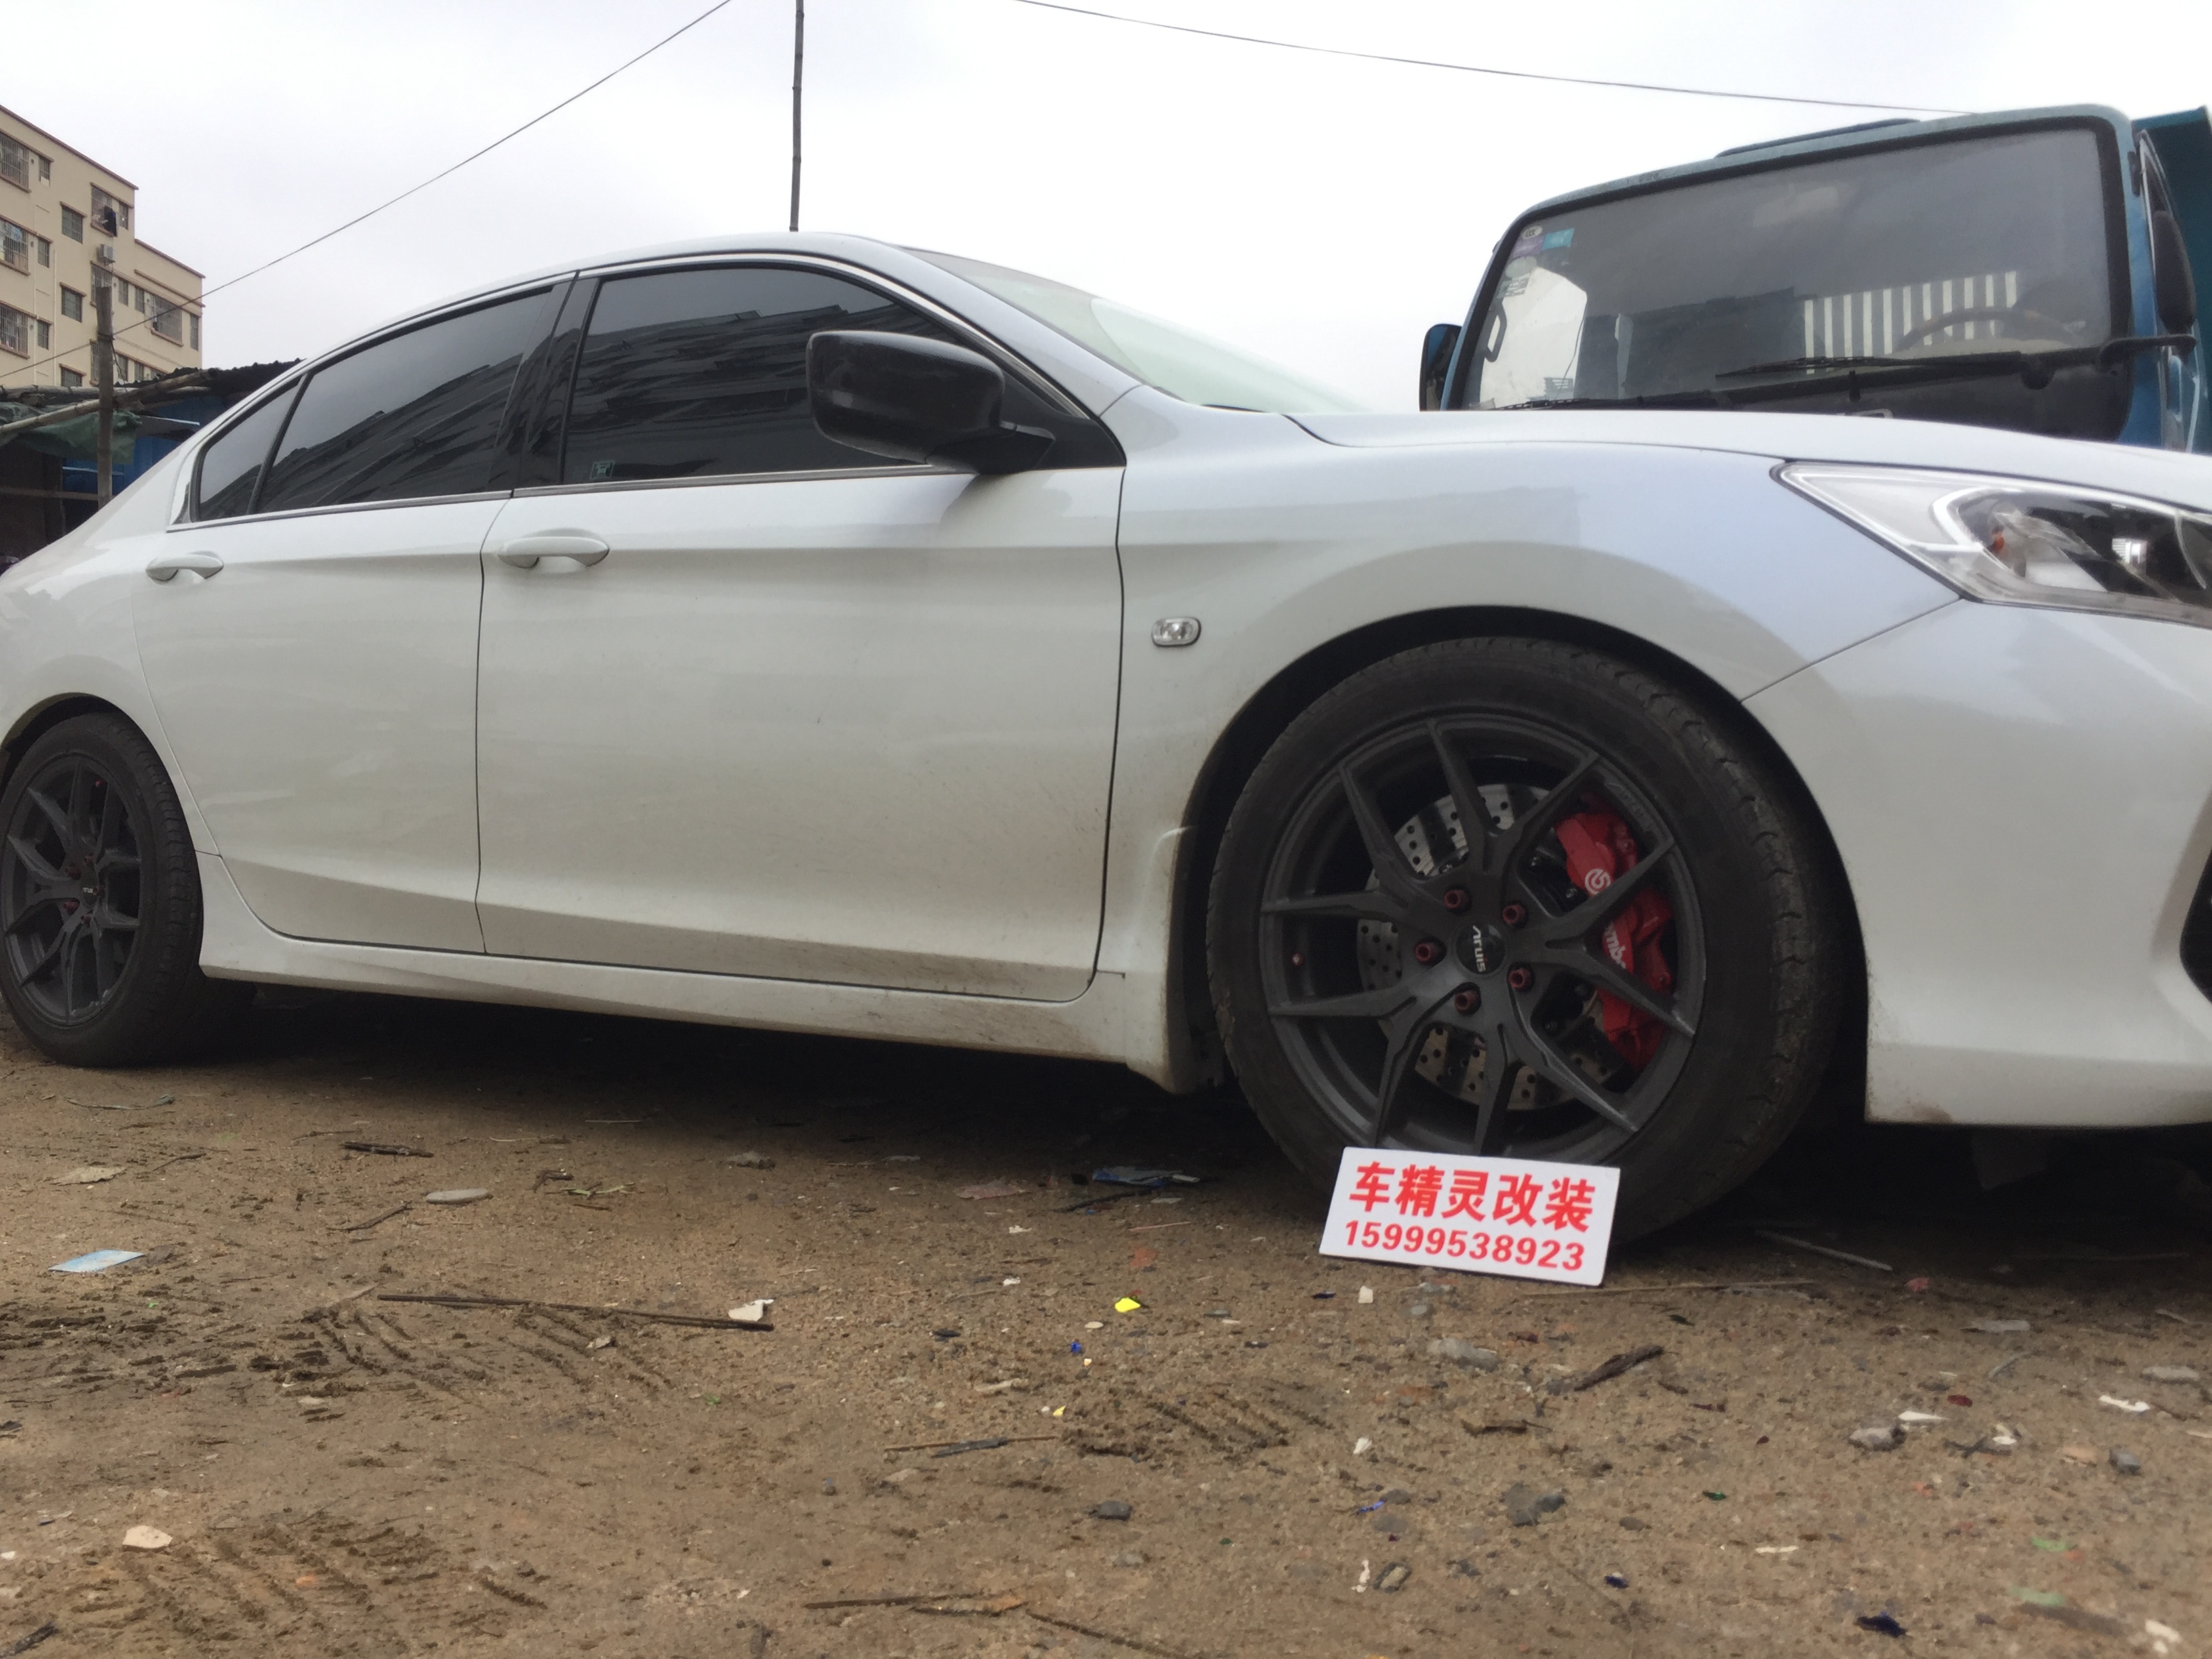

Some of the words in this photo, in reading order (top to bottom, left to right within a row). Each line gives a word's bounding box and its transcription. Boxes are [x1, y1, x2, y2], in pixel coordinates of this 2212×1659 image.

[1349, 1161, 1596, 1233] 车精灵改装
[1345, 1220, 1585, 1271] 15999538923
